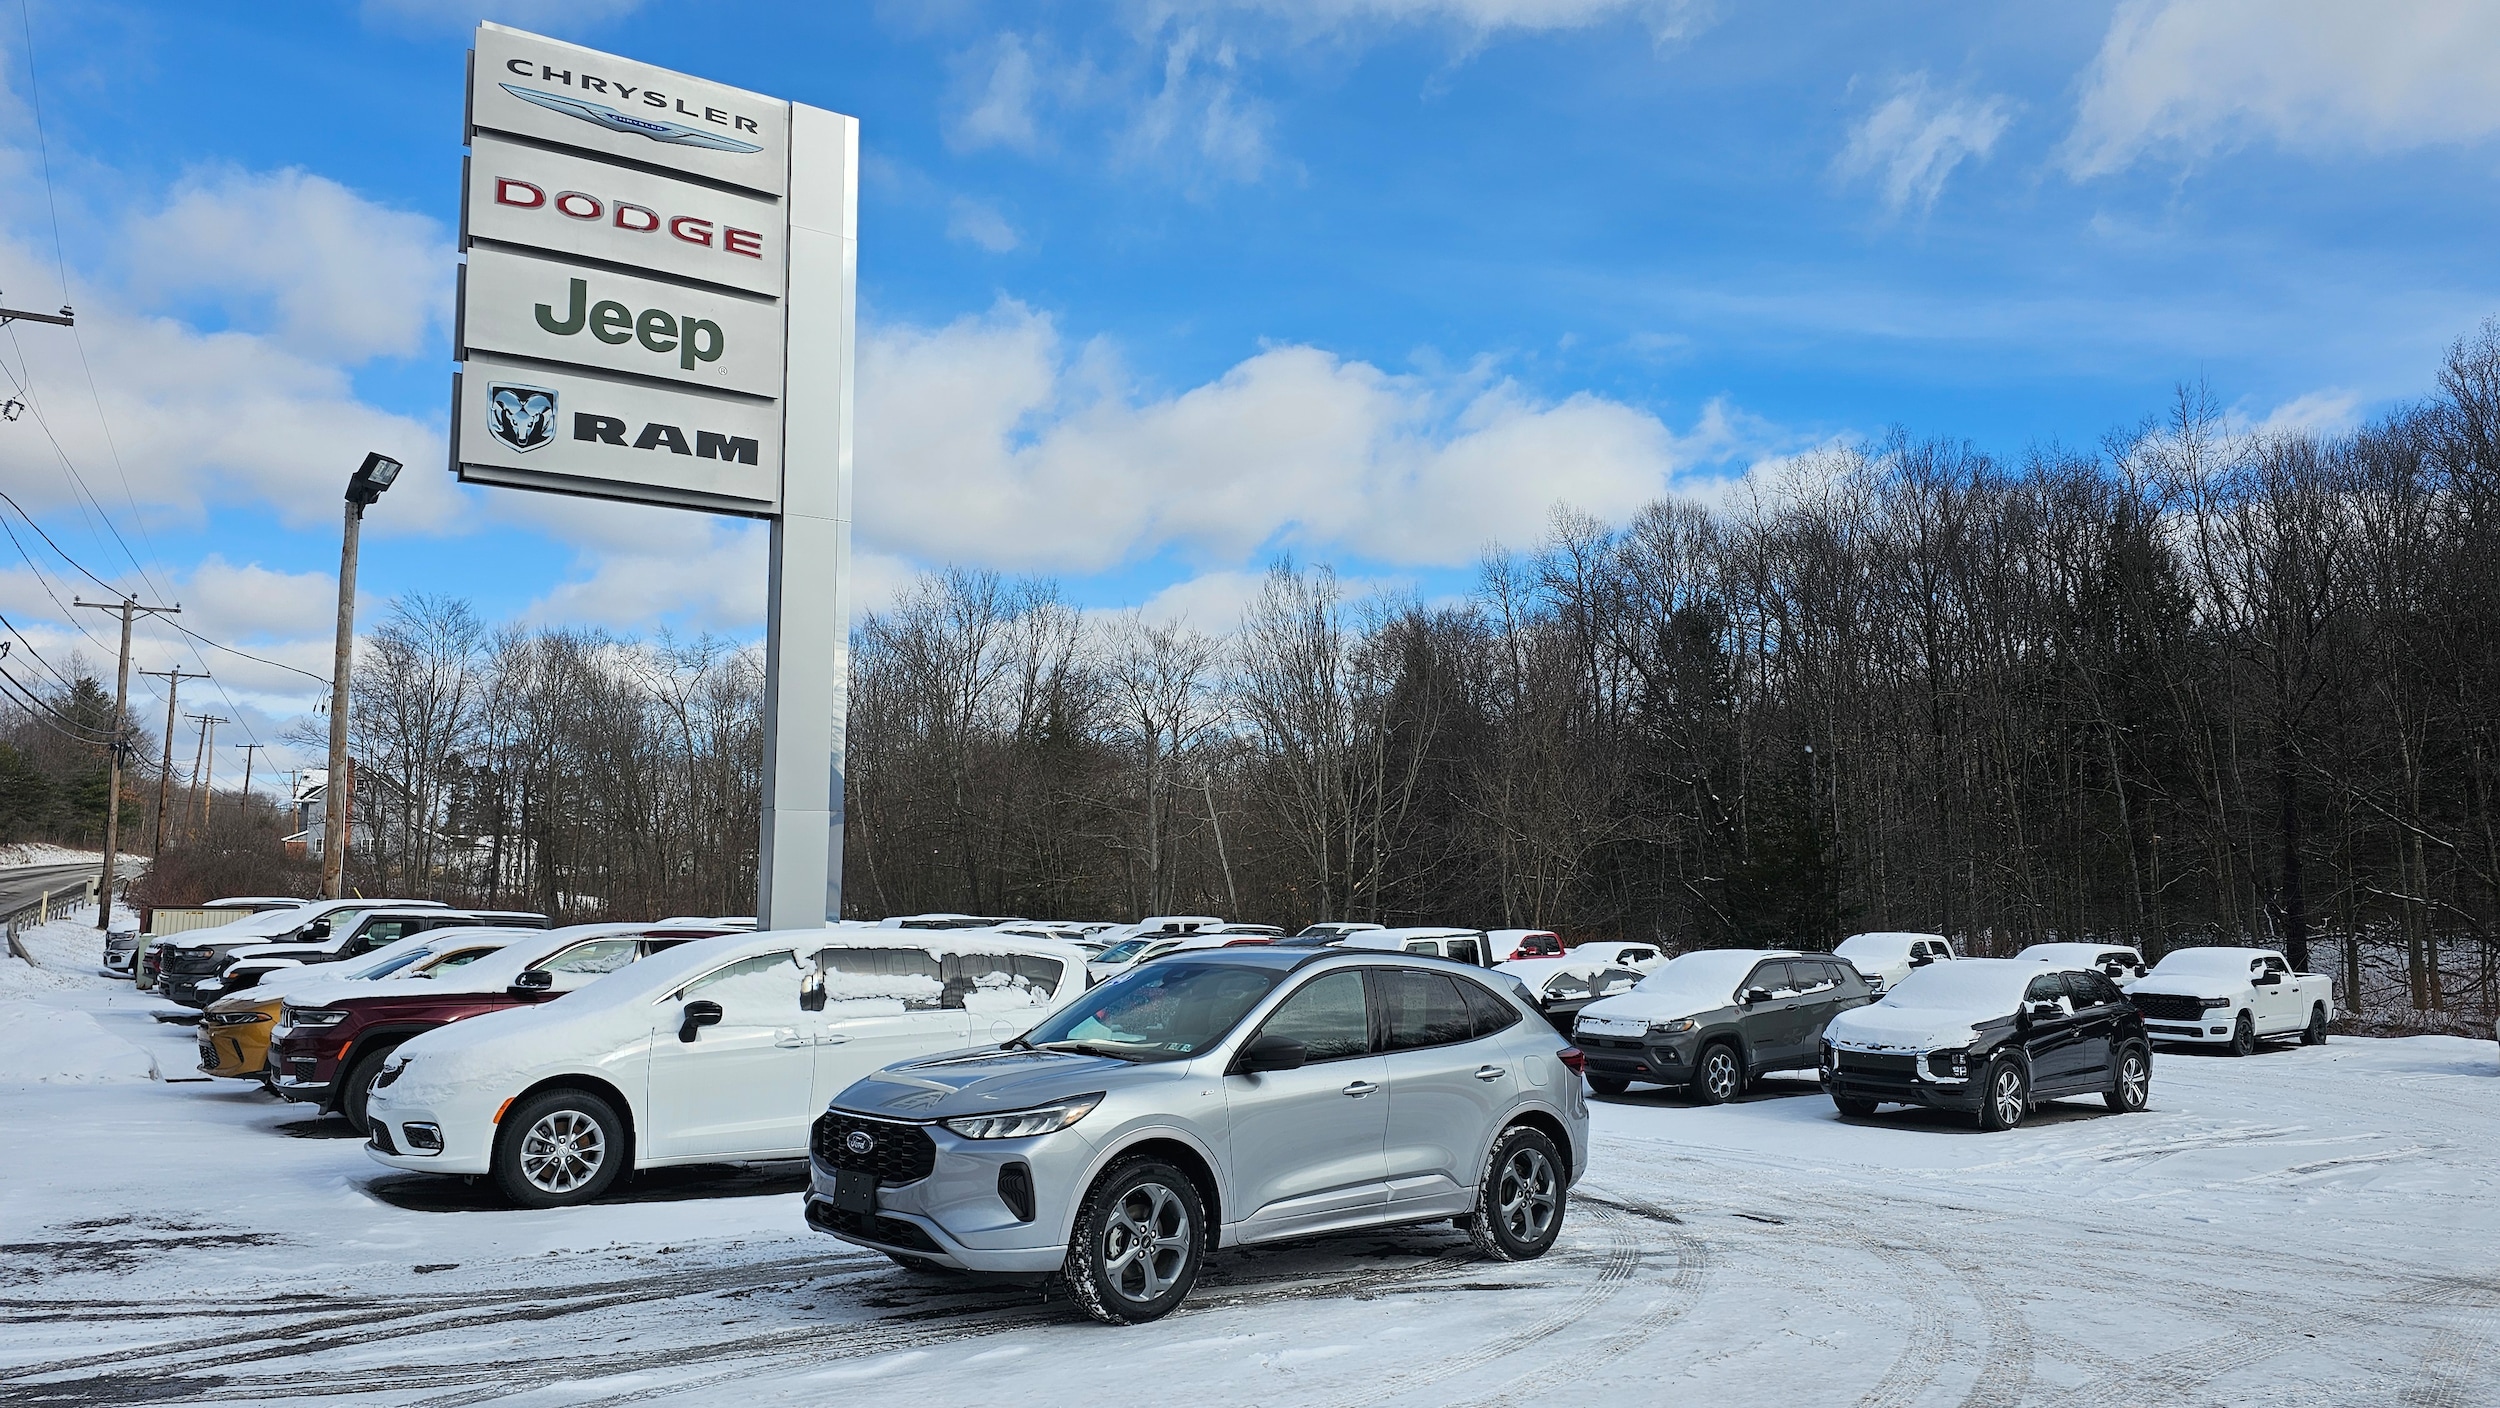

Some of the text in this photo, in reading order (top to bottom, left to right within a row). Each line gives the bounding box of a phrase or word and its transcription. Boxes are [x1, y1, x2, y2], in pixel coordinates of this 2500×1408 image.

[506, 59, 758, 135] CHRYSLER
[494, 176, 763, 260] DODGE
[534, 277, 724, 370] Jeep
[573, 411, 758, 466] RAM
